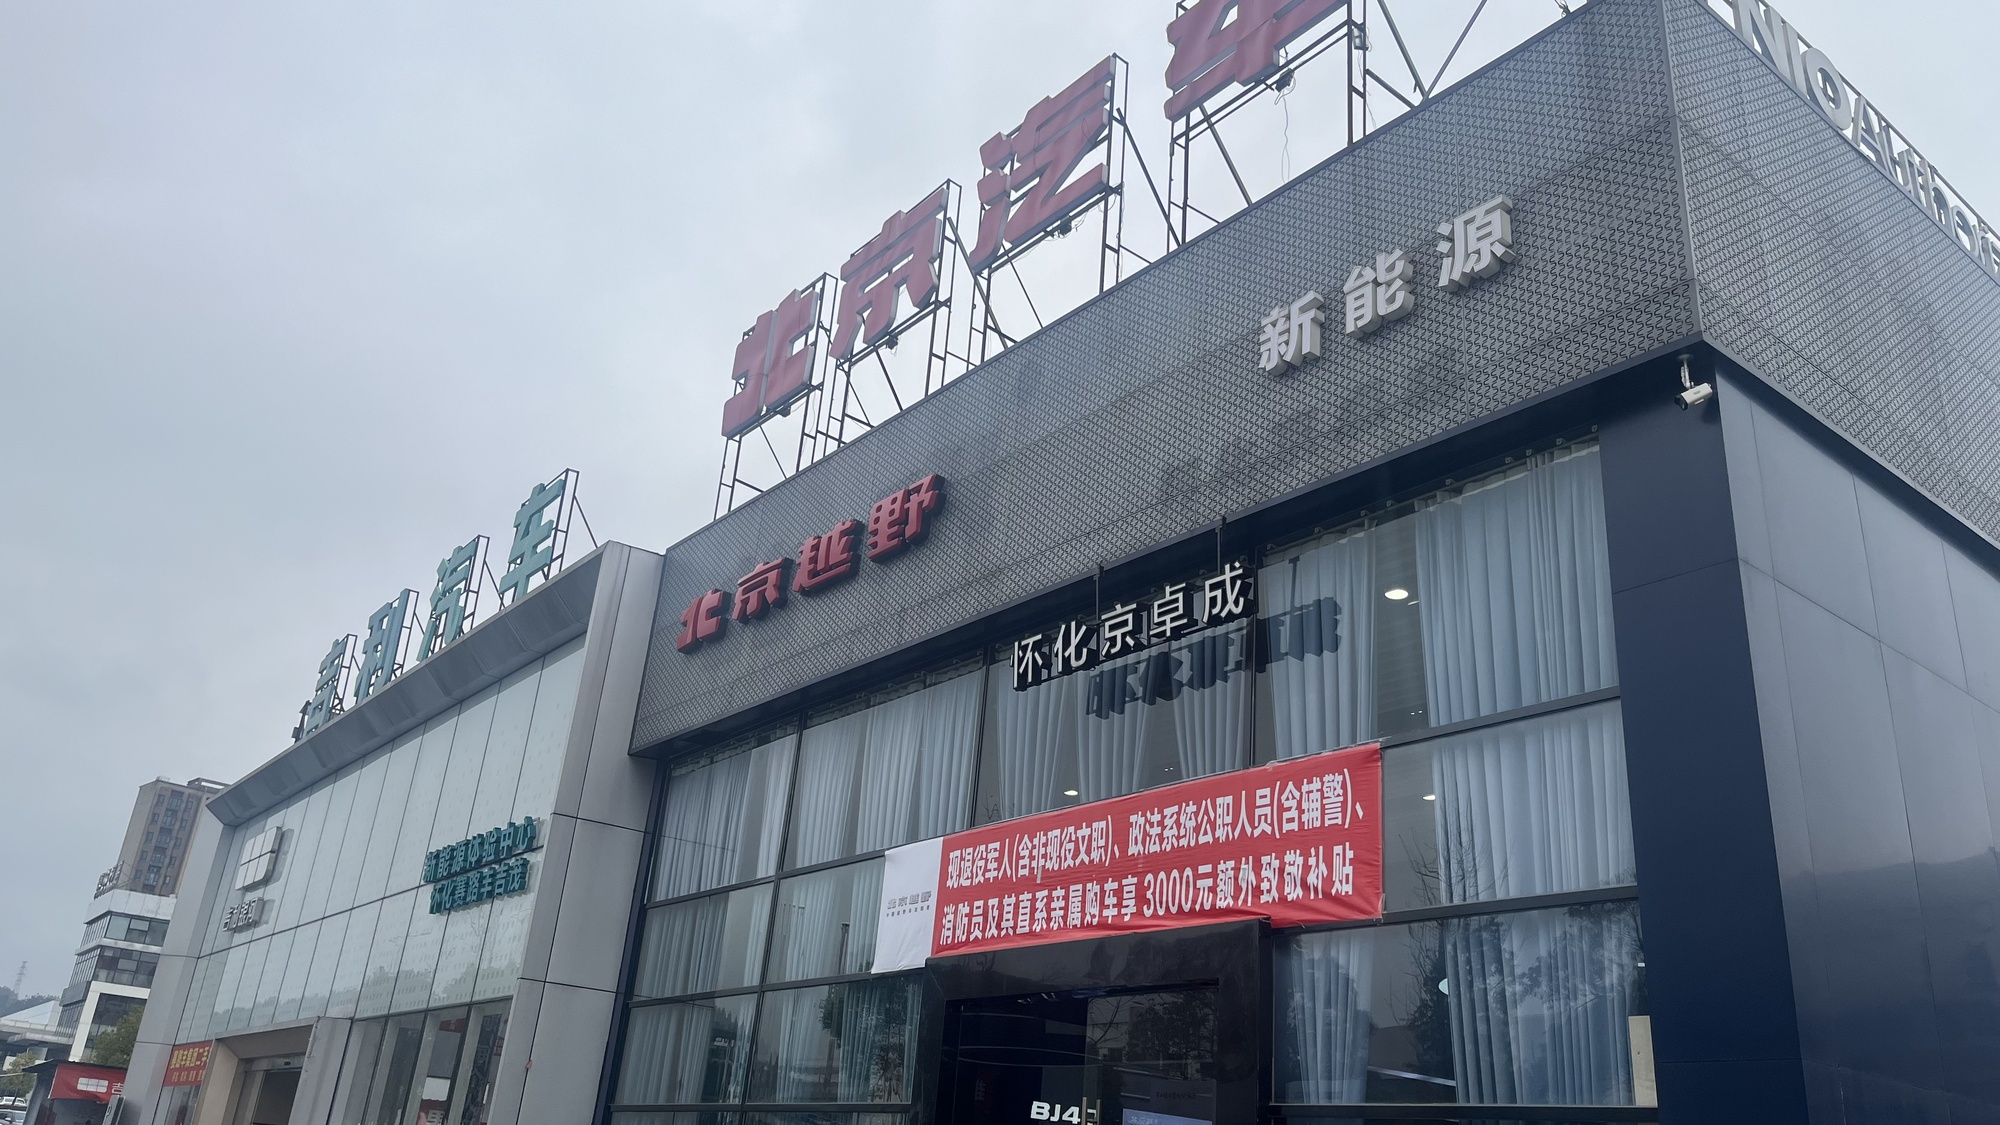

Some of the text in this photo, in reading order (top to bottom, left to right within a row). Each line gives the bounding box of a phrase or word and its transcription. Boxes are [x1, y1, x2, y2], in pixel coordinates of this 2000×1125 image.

[1850, 95, 2000, 282] Authori
[1258, 194, 1515, 377] 新能源
[302, 478, 565, 737] 吉利汽车
[676, 472, 945, 652] 北京越野
[1009, 560, 1247, 690] 怀化京卓成
[423, 816, 537, 882] 新能源体验中心
